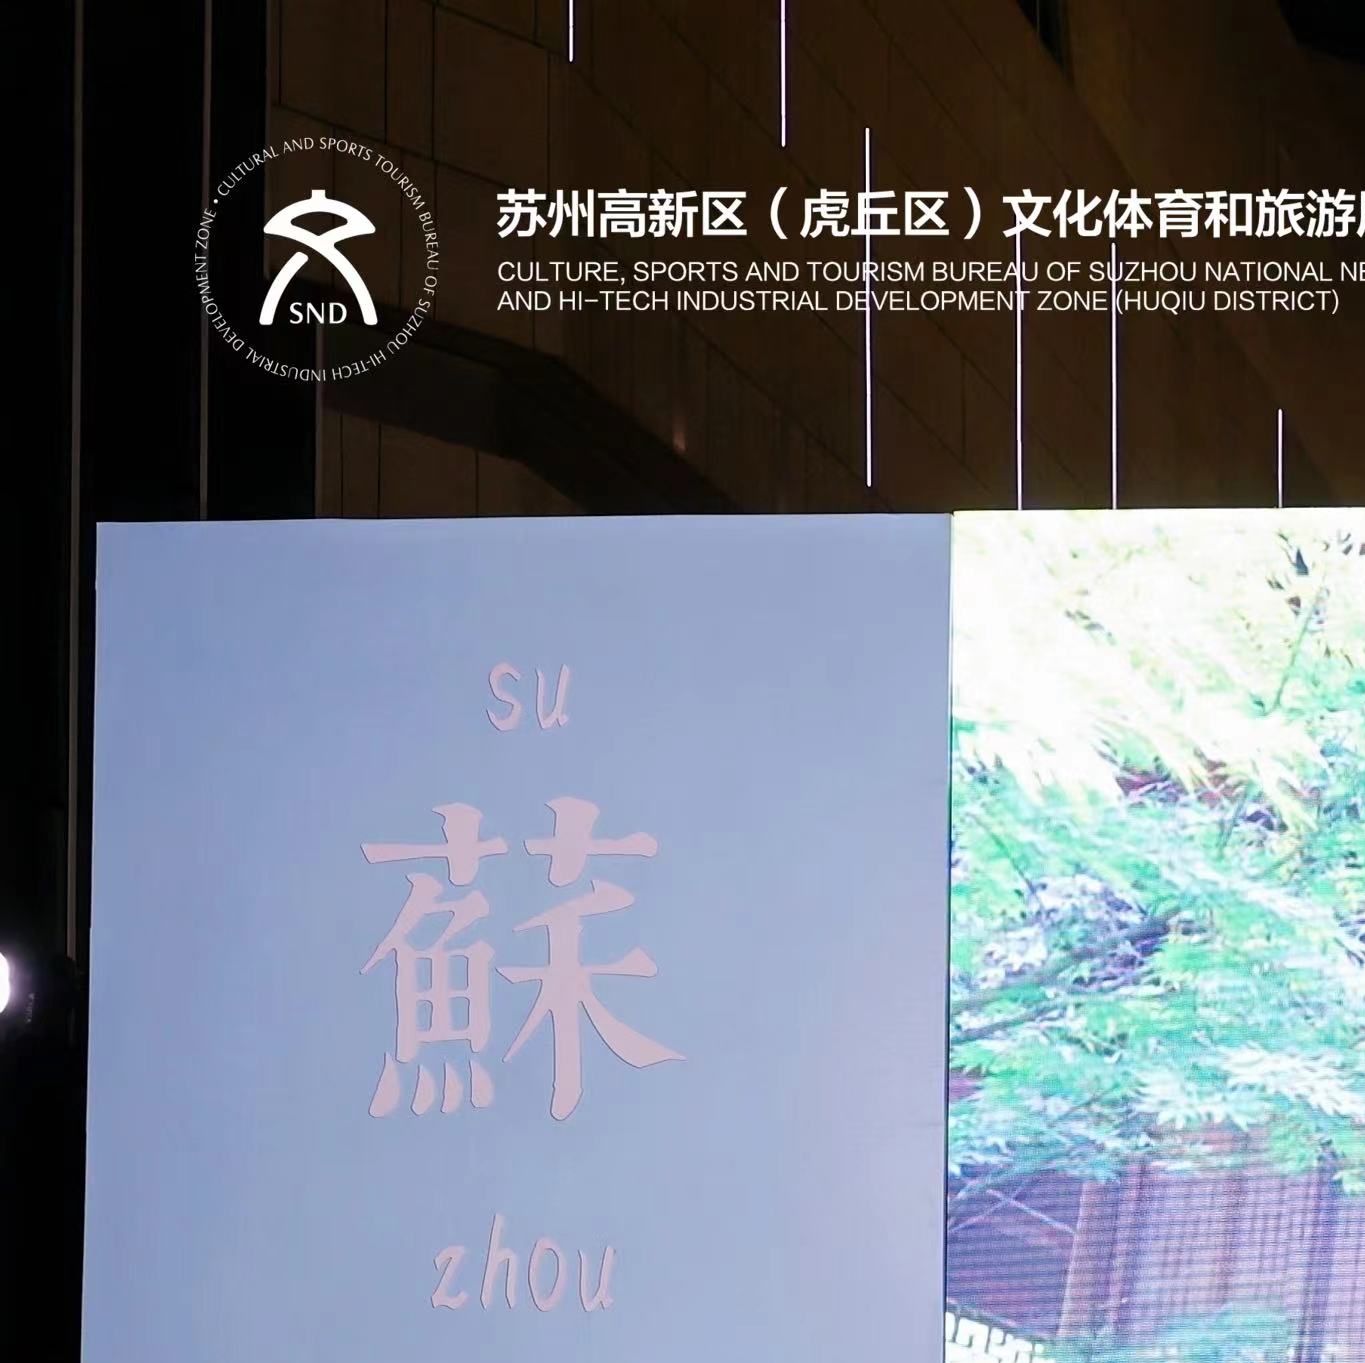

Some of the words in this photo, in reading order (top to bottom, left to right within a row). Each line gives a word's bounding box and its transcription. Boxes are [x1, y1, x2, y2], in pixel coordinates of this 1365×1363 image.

[486, 661, 571, 731] su
[359, 796, 687, 1121] 蘇
[430, 1213, 615, 1313] zhou
